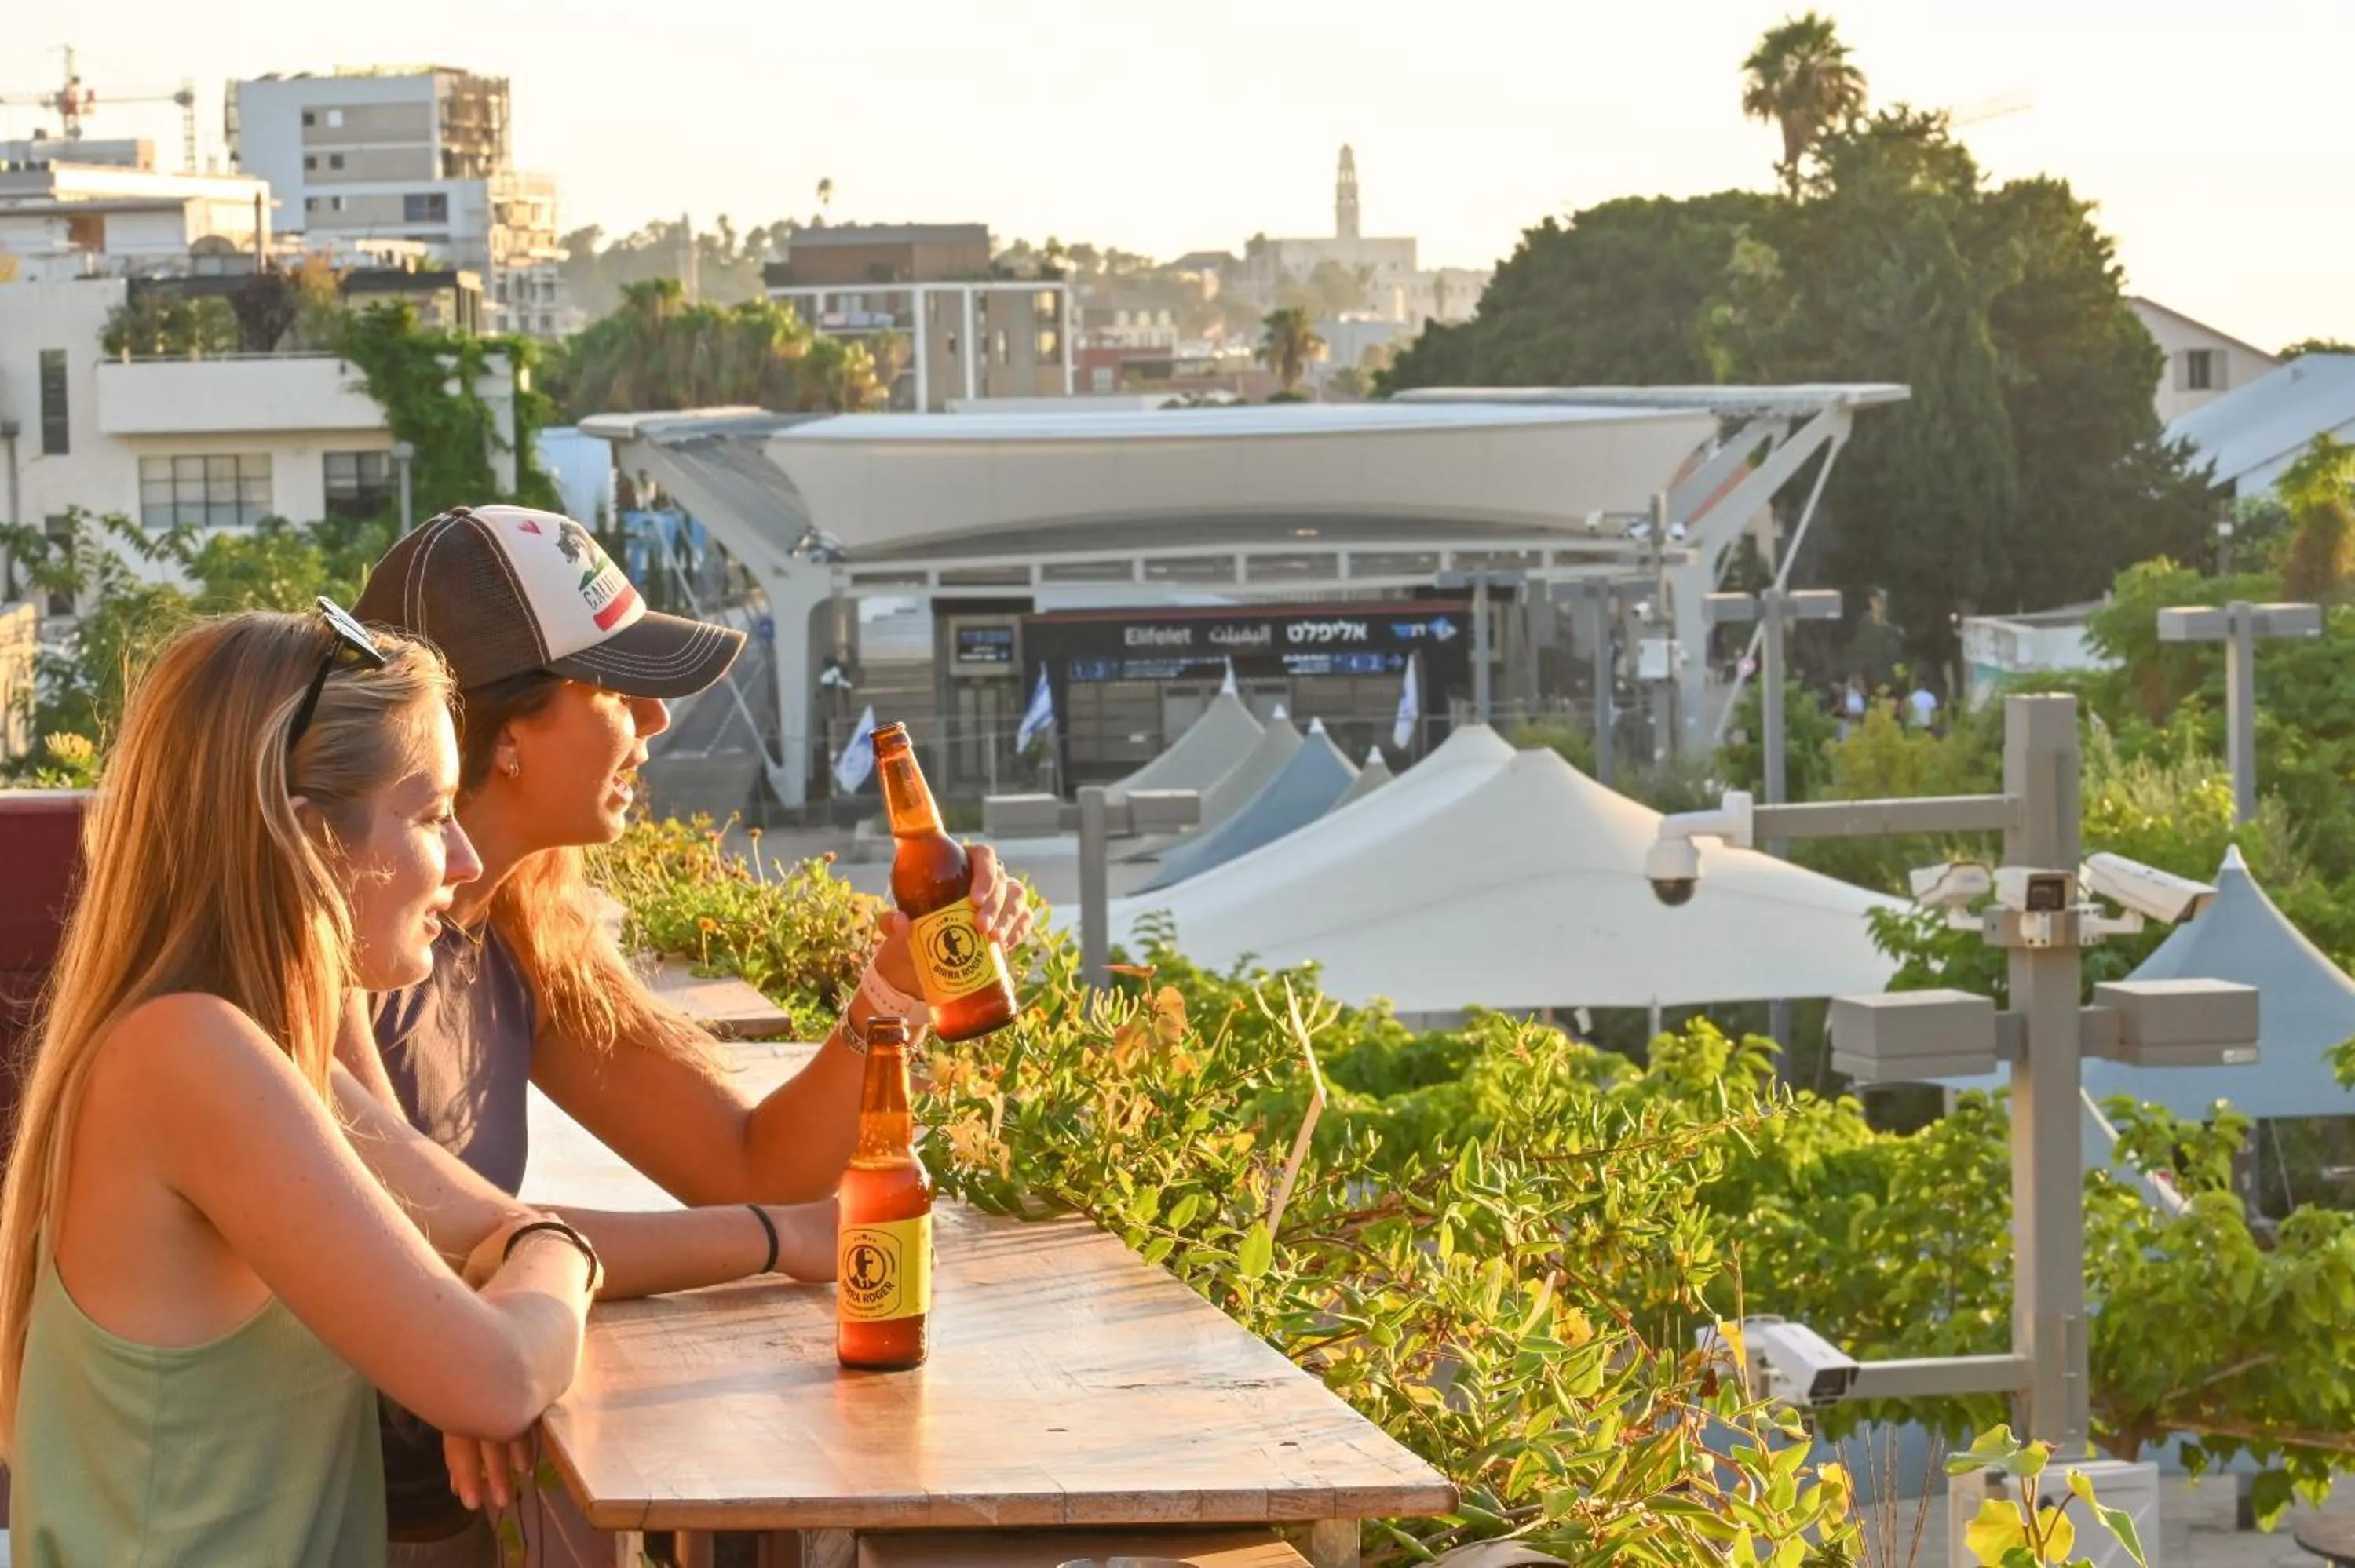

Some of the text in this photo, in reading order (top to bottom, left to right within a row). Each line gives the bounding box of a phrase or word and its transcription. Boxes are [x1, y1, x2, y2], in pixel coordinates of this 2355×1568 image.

[1124, 625, 1193, 646] Elifelet
[1286, 619, 1368, 643] אליפלט
[862, 1281, 898, 1304] ROGER
